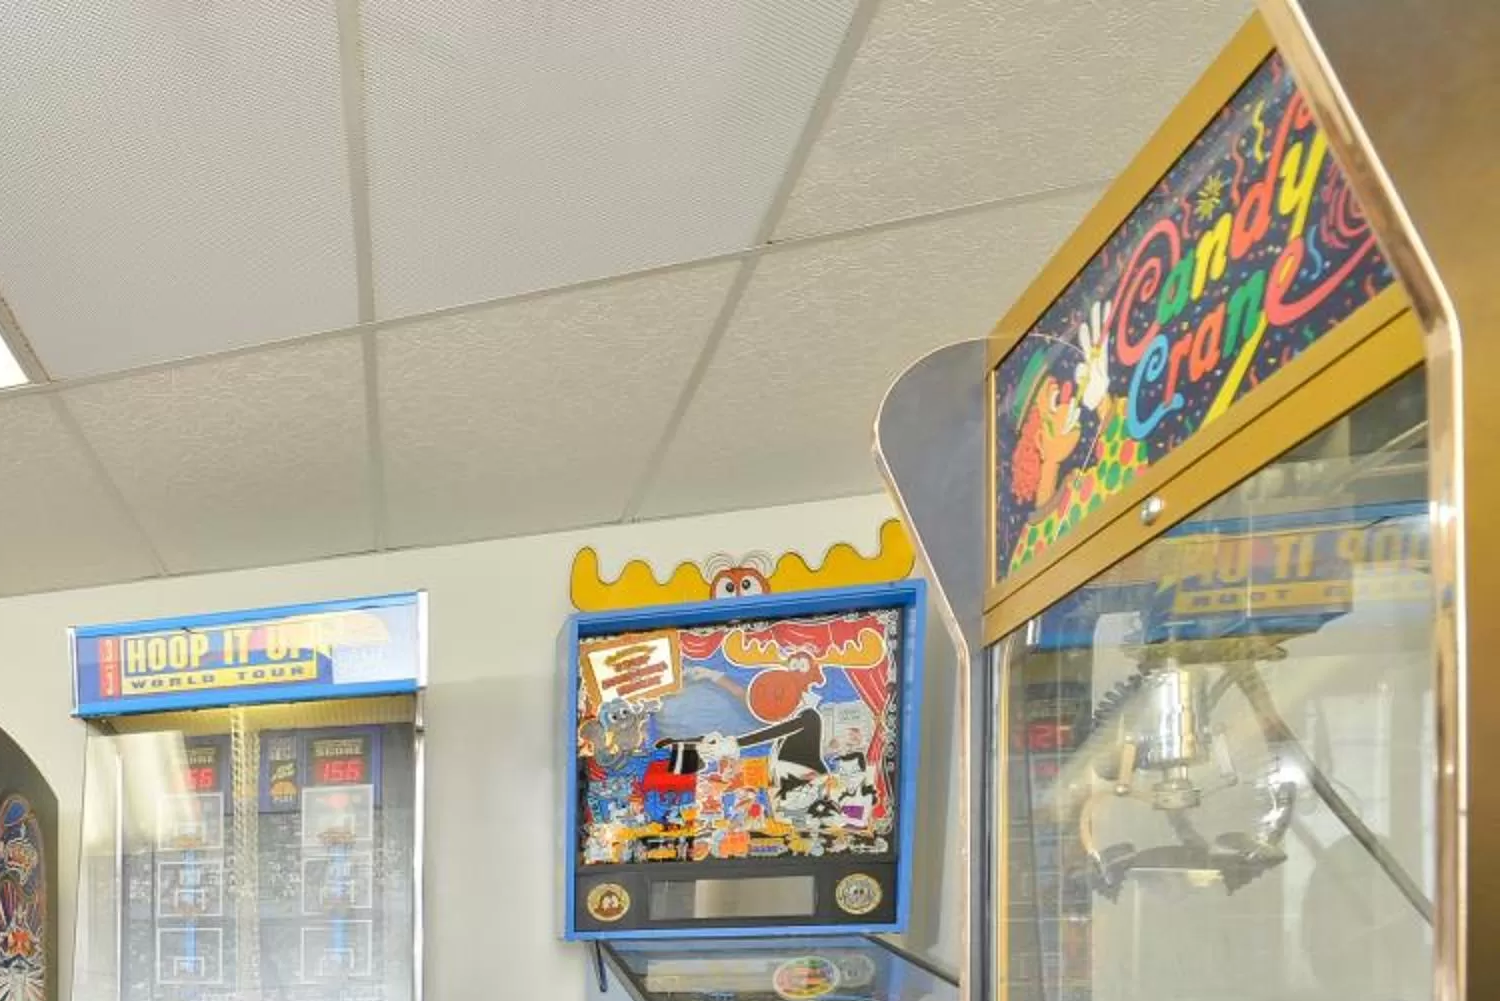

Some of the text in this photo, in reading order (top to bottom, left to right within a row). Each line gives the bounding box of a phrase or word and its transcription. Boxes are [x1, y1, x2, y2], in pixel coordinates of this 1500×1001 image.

[1110, 90, 1327, 366] Candy
[1128, 238, 1335, 438] Crane
[126, 632, 210, 674] HOOP
[222, 629, 251, 666] IT
[130, 665, 306, 690] WORLD TOUR
